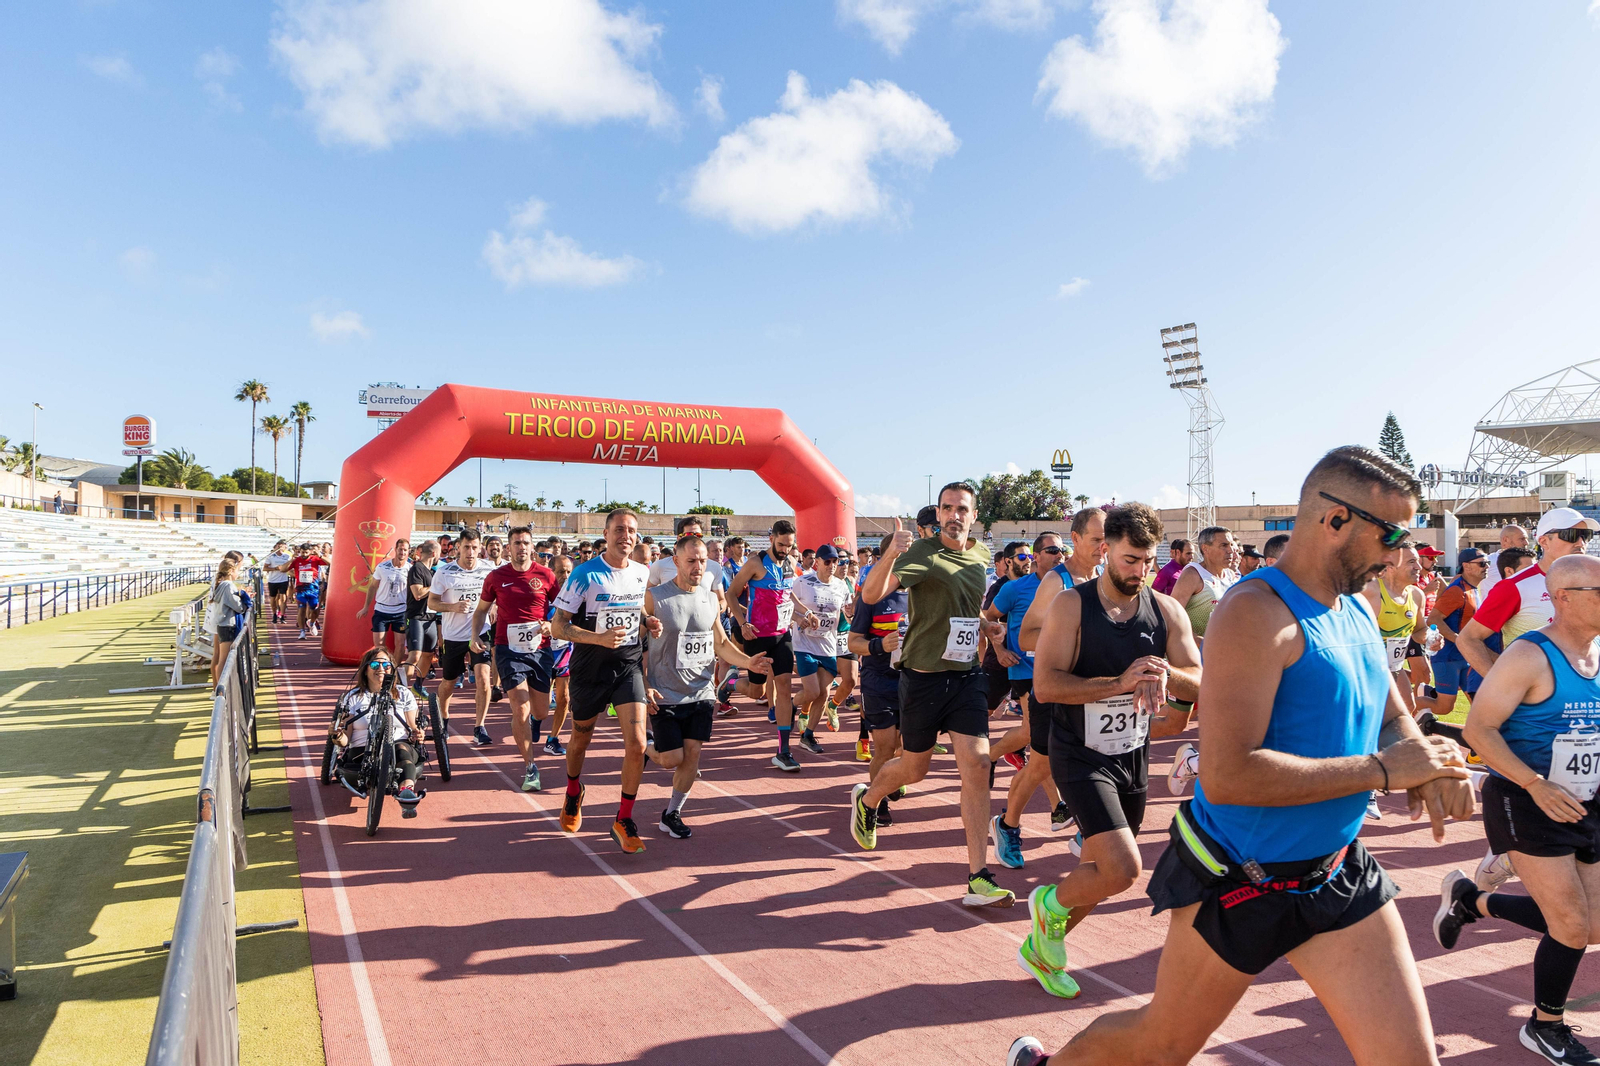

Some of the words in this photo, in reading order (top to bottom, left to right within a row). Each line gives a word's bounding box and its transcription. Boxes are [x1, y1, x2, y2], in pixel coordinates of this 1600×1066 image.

[369, 394, 422, 405] Carrefour
[530, 397, 629, 415] INFANTERÍA
[632, 404, 654, 416] DE
[657, 406, 722, 420] MARINA
[503, 411, 597, 440] TERCIO
[603, 418, 635, 442] DE
[641, 420, 746, 446] ARMADA
[124, 431, 150, 441] KING
[592, 443, 660, 462] META
[459, 593, 478, 602] 453
[606, 616, 632, 630] 893
[518, 631, 533, 643] 26
[685, 641, 707, 655] 991
[1564, 702, 1600, 710] MEMOR
[1100, 712, 1138, 734] 231
[1566, 752, 1600, 775] 497
